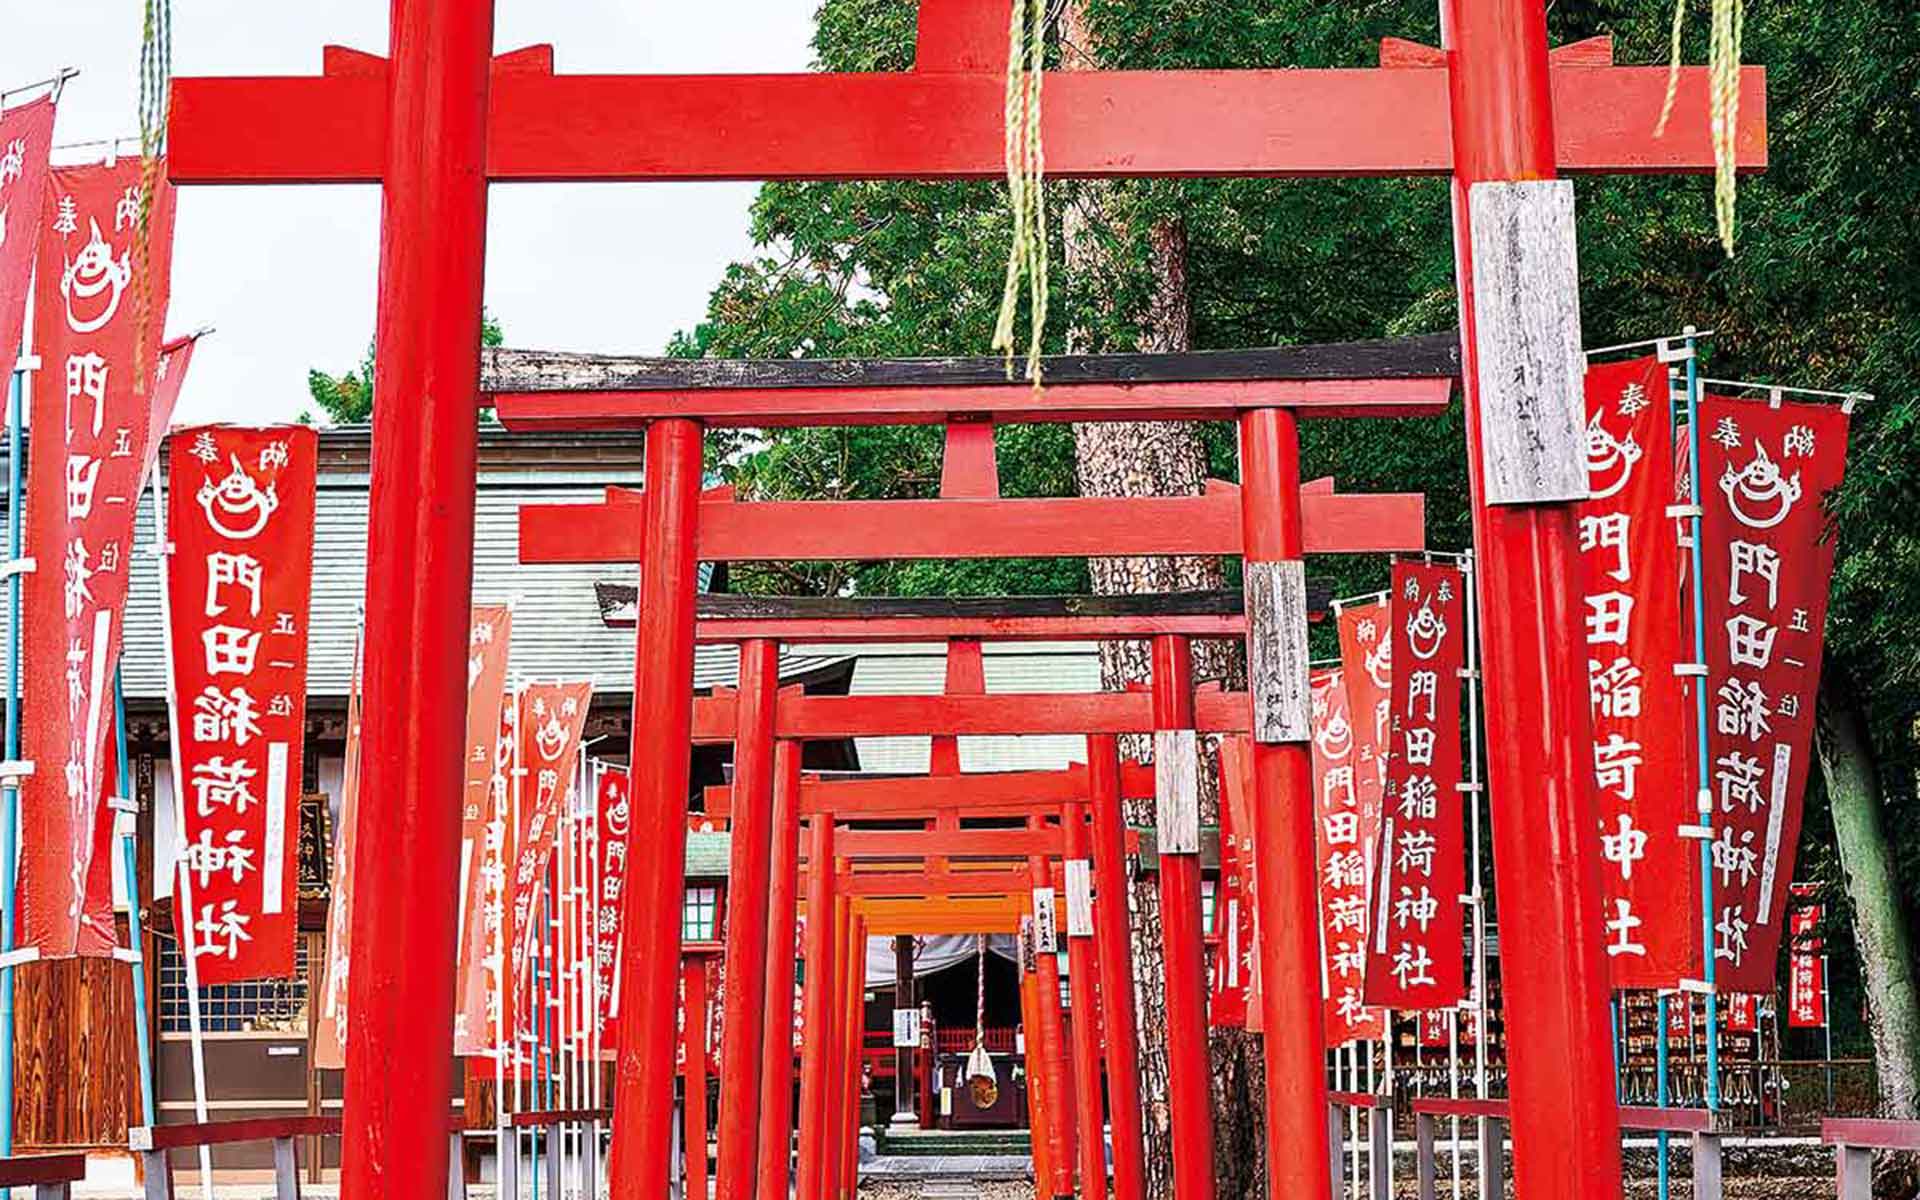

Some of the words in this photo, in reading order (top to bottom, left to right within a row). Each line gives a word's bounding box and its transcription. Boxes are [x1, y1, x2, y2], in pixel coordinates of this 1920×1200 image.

[1616, 383, 1650, 417] 奉
[1322, 765, 1375, 1028] 門田稲荷神社
[1390, 669, 1441, 990] 門田稲荷神社
